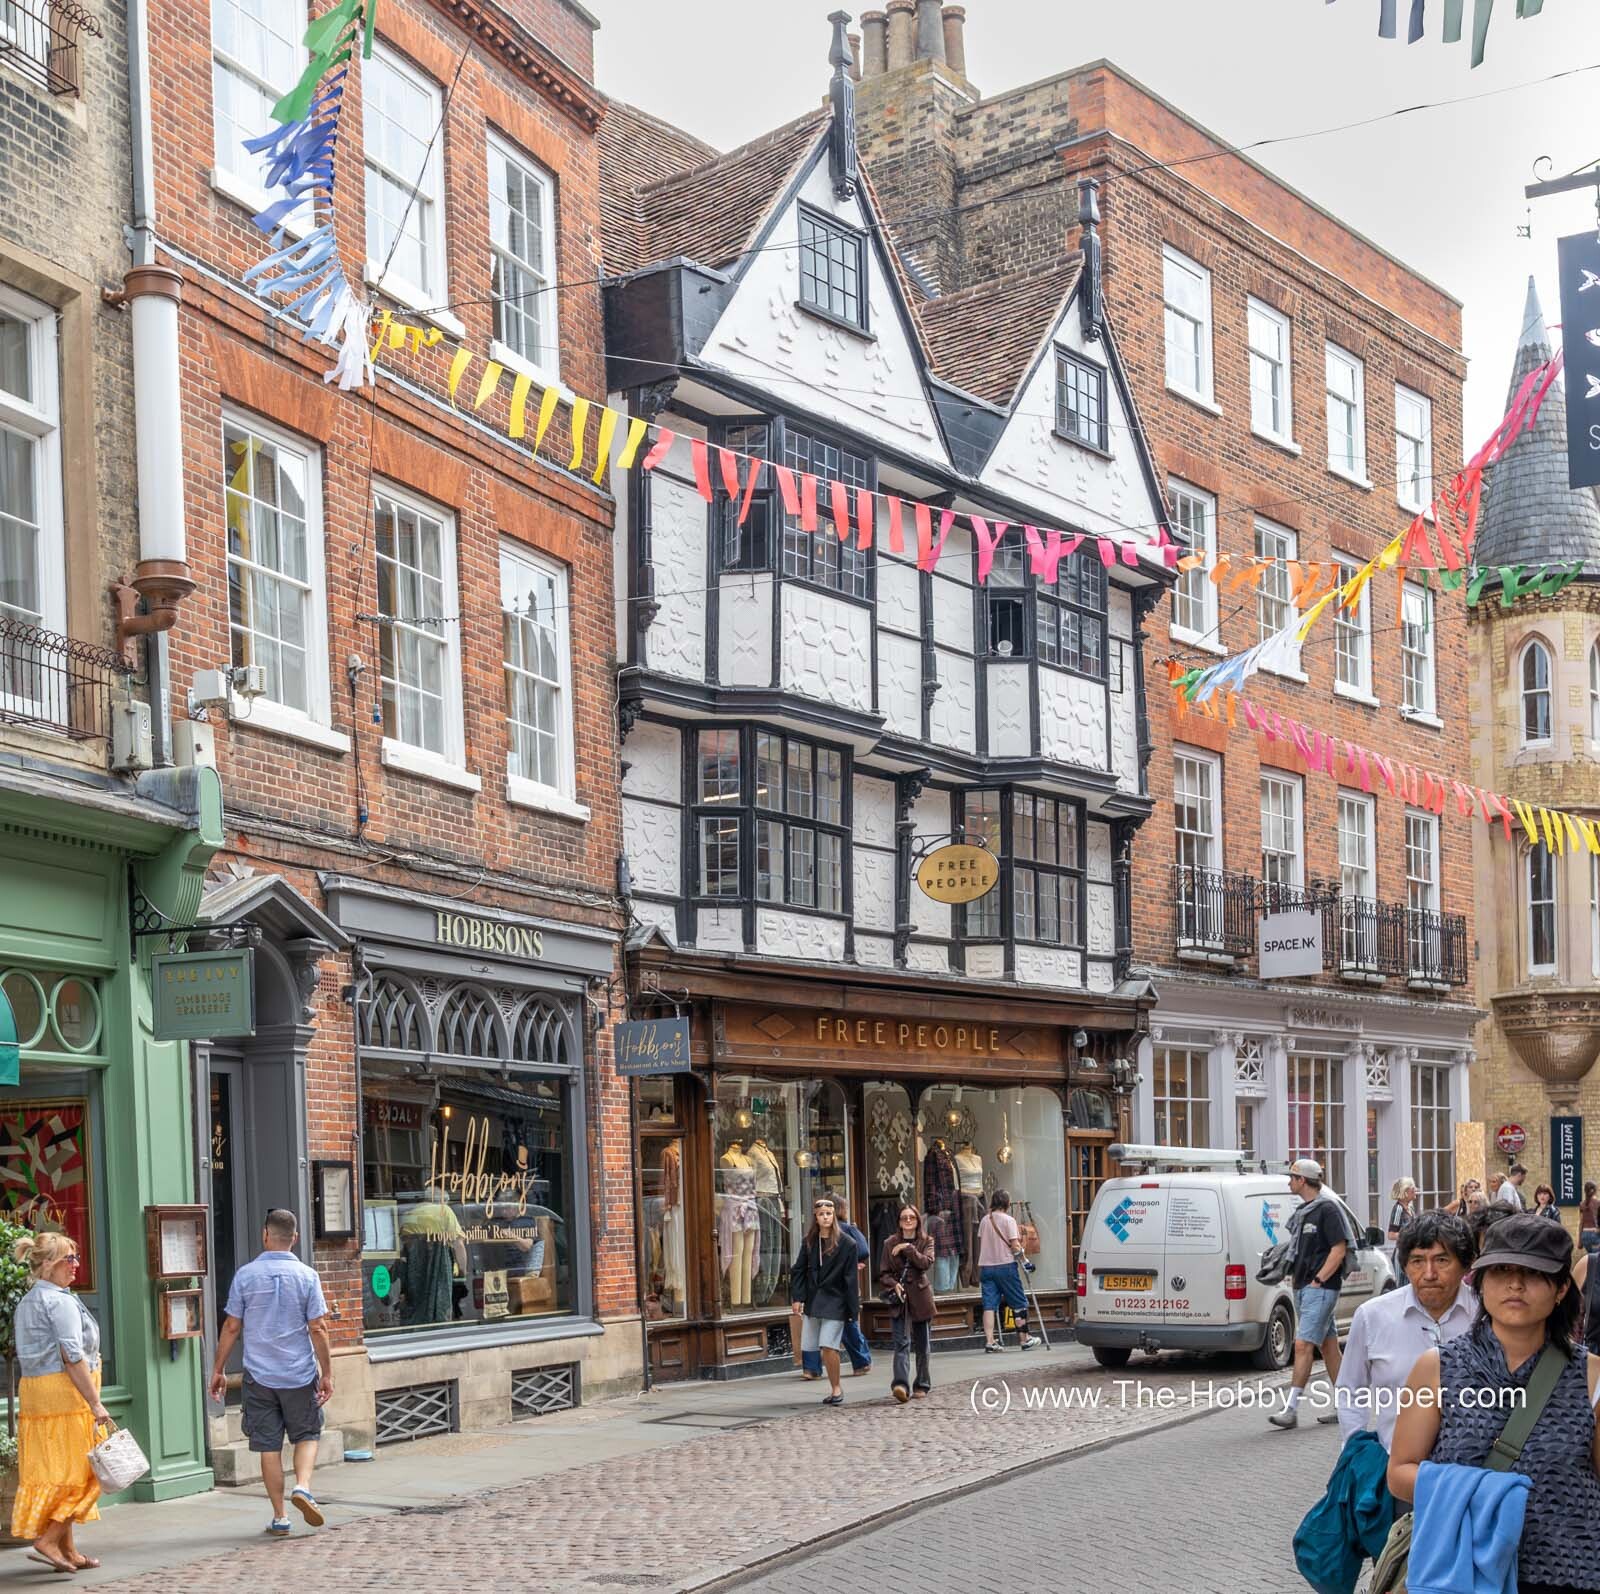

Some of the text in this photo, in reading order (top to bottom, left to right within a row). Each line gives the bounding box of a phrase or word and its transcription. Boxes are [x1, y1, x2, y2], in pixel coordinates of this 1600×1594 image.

[938, 859, 976, 872] FREE
[926, 875, 988, 889] PEOPLE
[436, 911, 544, 959] HOBBSONS
[1264, 936, 1315, 952] SPACE.NK
[165, 966, 239, 984] THE IVY
[175, 992, 231, 1005] CAMBRIDGE
[175, 1003, 230, 1016] BRASSERIE
[817, 1017, 1000, 1051] FREE PEOPLE
[1563, 1124, 1574, 1199] WHITE STUFF
[31, 1208, 67, 1226] IVY
[493, 1225, 539, 1240] Restaurant
[1106, 1276, 1149, 1287] LS15 HKA
[1115, 1298, 1190, 1310] 01223 212162
